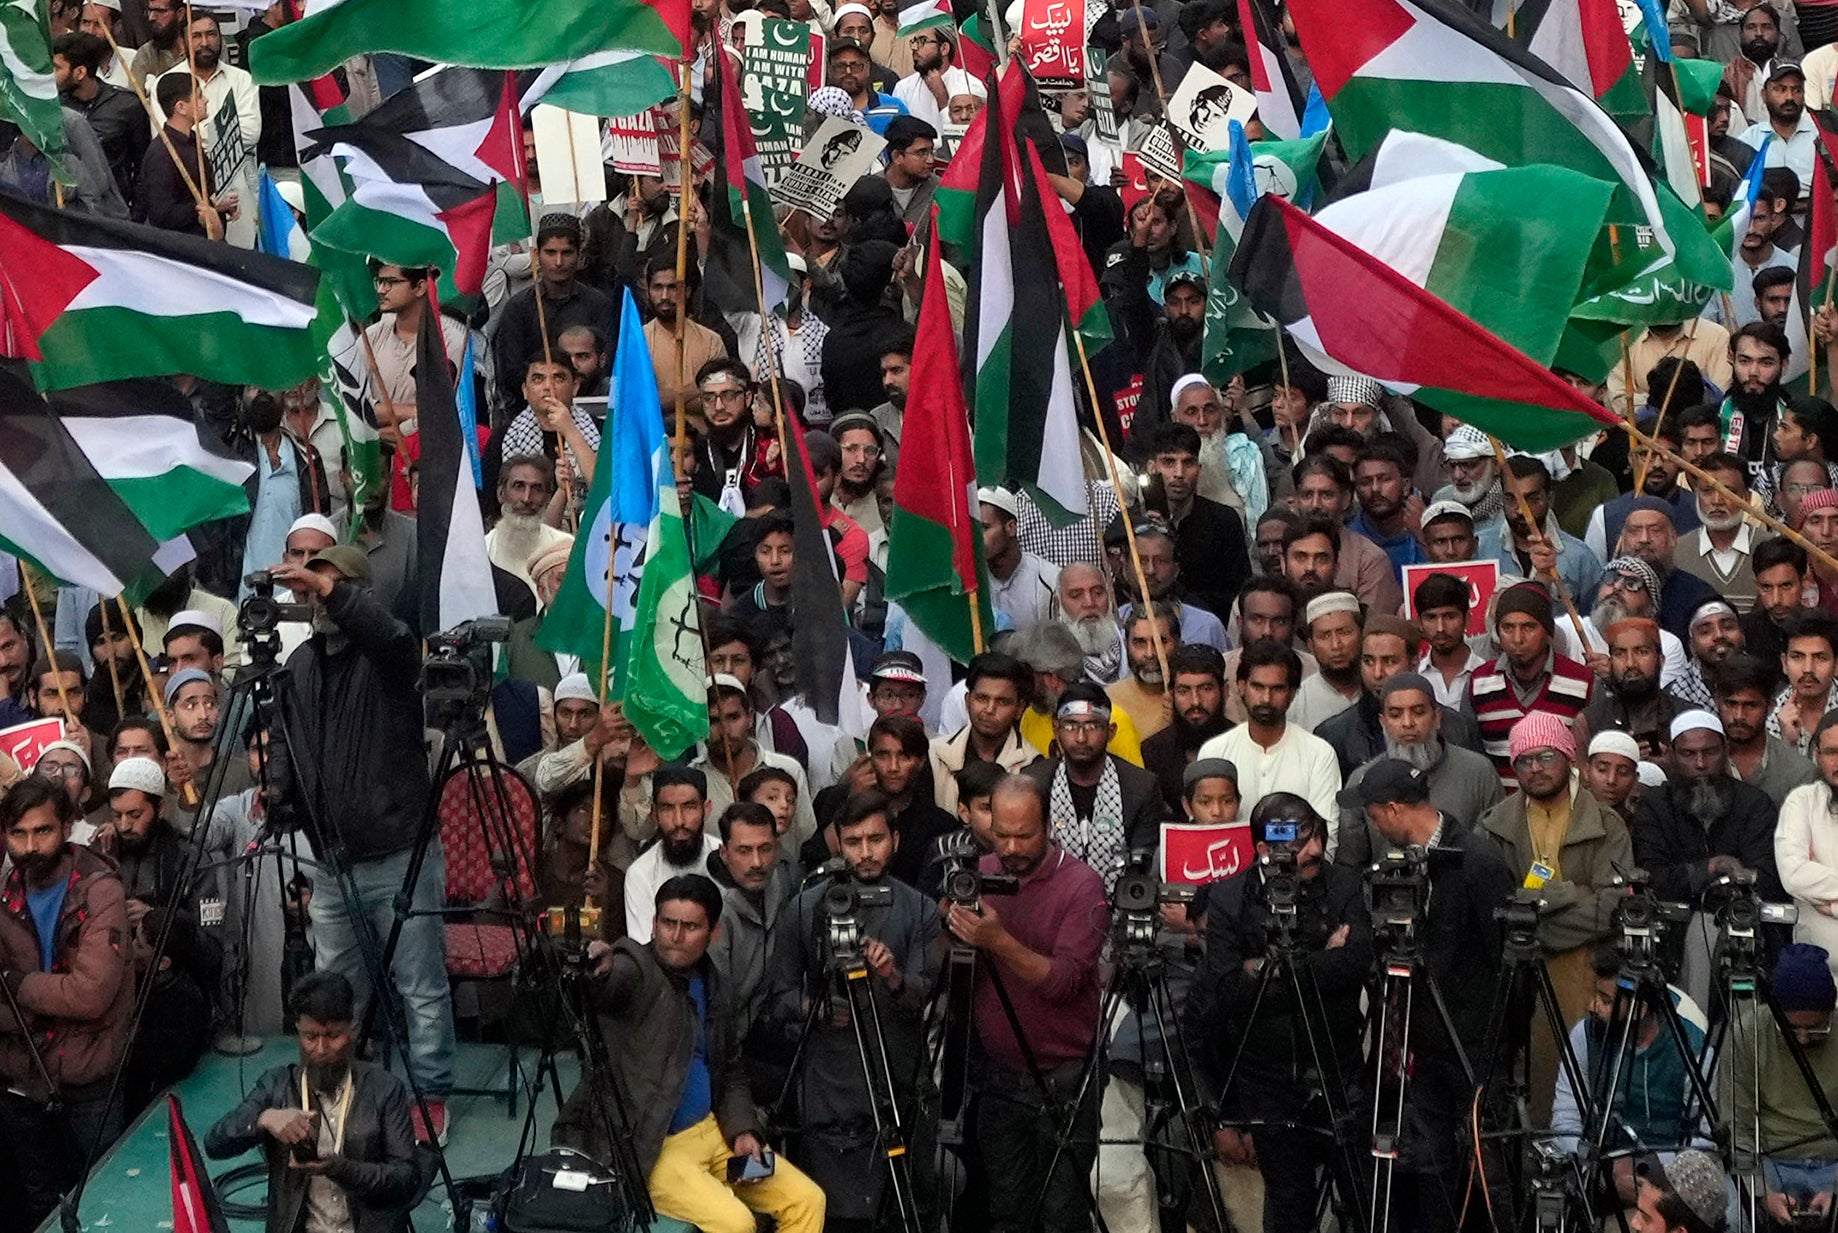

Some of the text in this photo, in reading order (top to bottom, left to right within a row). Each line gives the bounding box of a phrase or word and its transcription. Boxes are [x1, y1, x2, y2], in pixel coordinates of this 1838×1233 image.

[746, 47, 807, 65] I AM HUMAN
[753, 60, 771, 74] AM
[774, 63, 806, 78] WITH
[618, 111, 655, 131] GAZA
[755, 141, 788, 152] UMAN
[791, 162, 832, 181] ISRAEL
